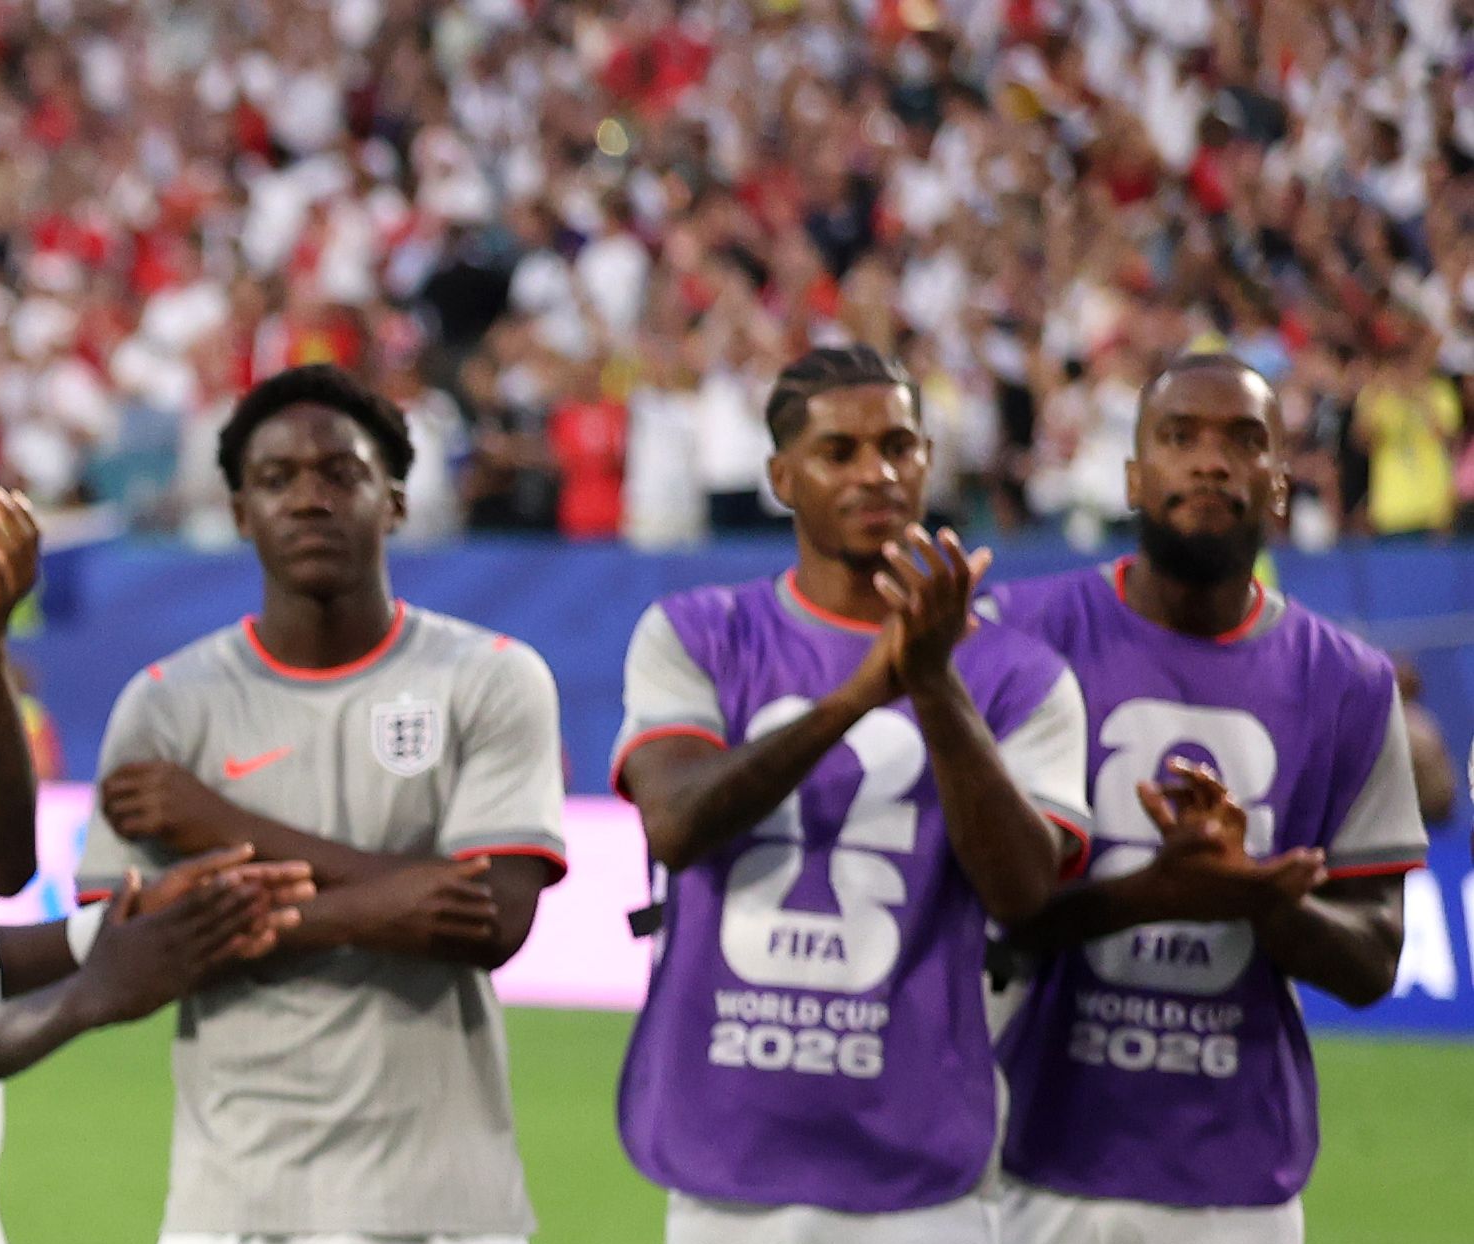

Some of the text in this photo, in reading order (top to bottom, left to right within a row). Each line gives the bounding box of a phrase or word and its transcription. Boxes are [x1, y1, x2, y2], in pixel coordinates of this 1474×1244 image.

[768, 930, 848, 963] FIFA
[1131, 931, 1211, 966] FIFA
[715, 989, 891, 1032] WORLD CUP
[1075, 989, 1244, 1033] WORLD CUP
[707, 1018, 885, 1079] 2026
[1067, 1020, 1240, 1079] 2026
